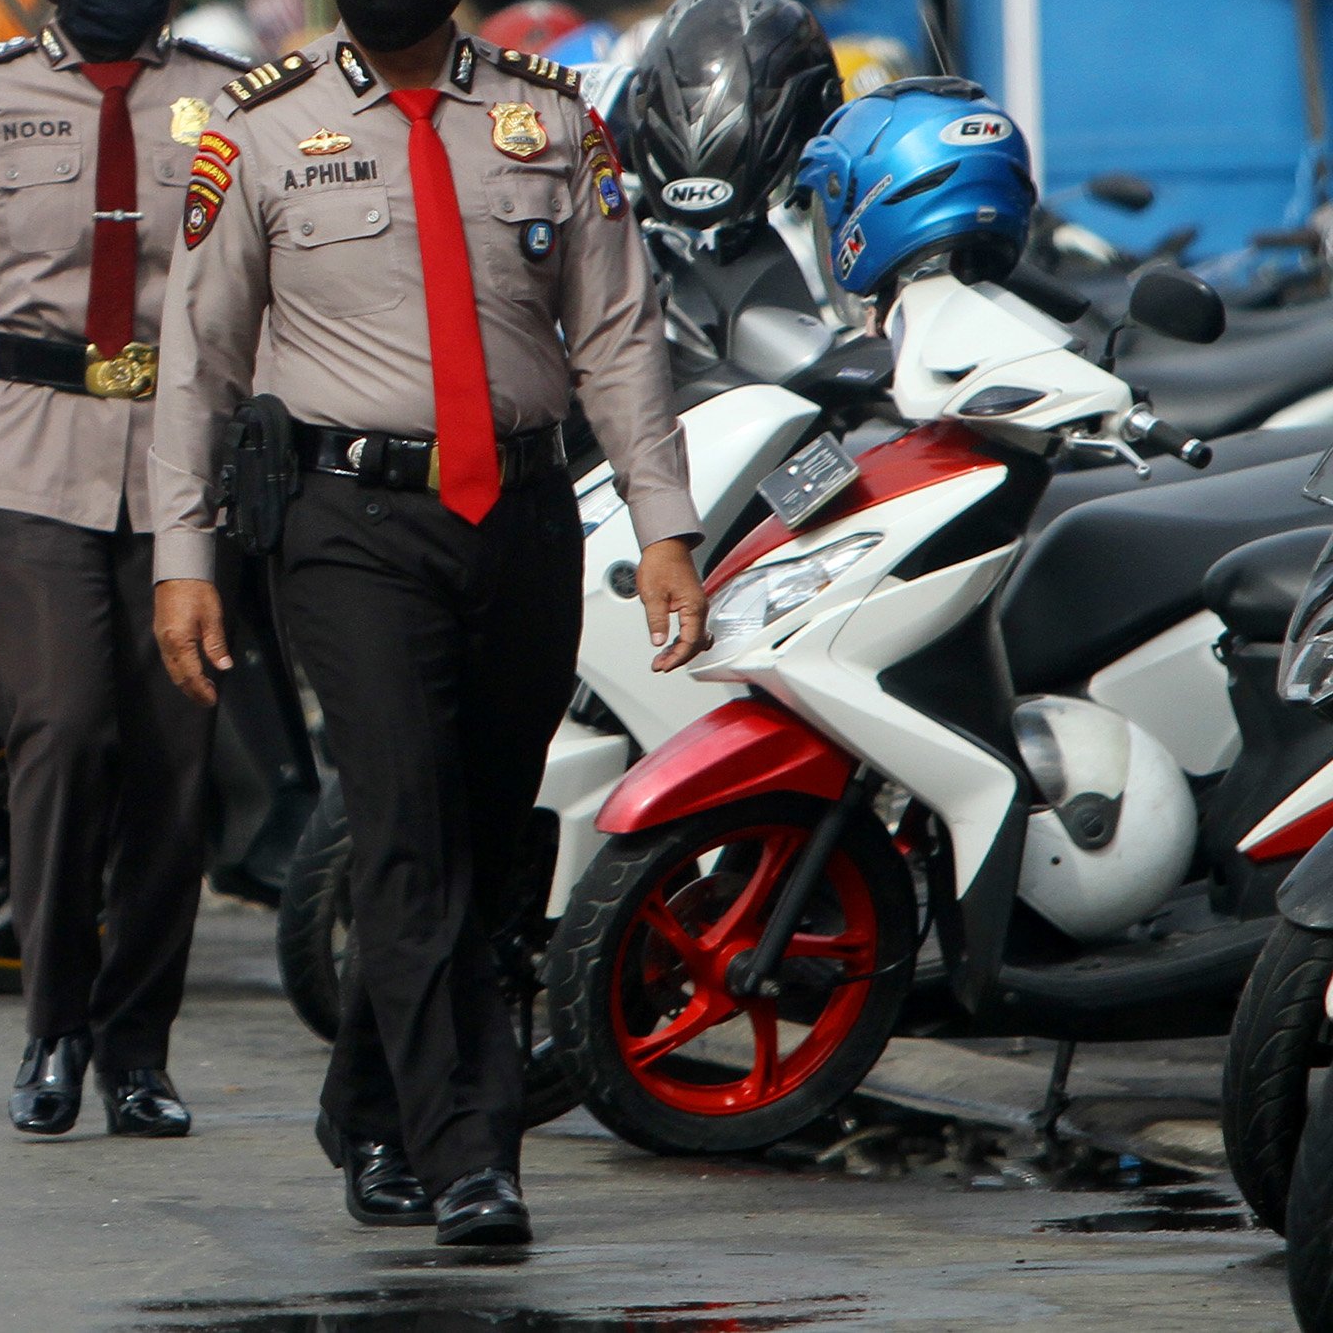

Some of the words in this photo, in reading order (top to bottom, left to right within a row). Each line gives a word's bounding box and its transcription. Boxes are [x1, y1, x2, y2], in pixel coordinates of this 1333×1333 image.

[3, 119, 72, 141] NOOR
[960, 120, 1002, 137] GM
[283, 159, 378, 191] A.PHILMI
[670, 182, 721, 202] NHK
